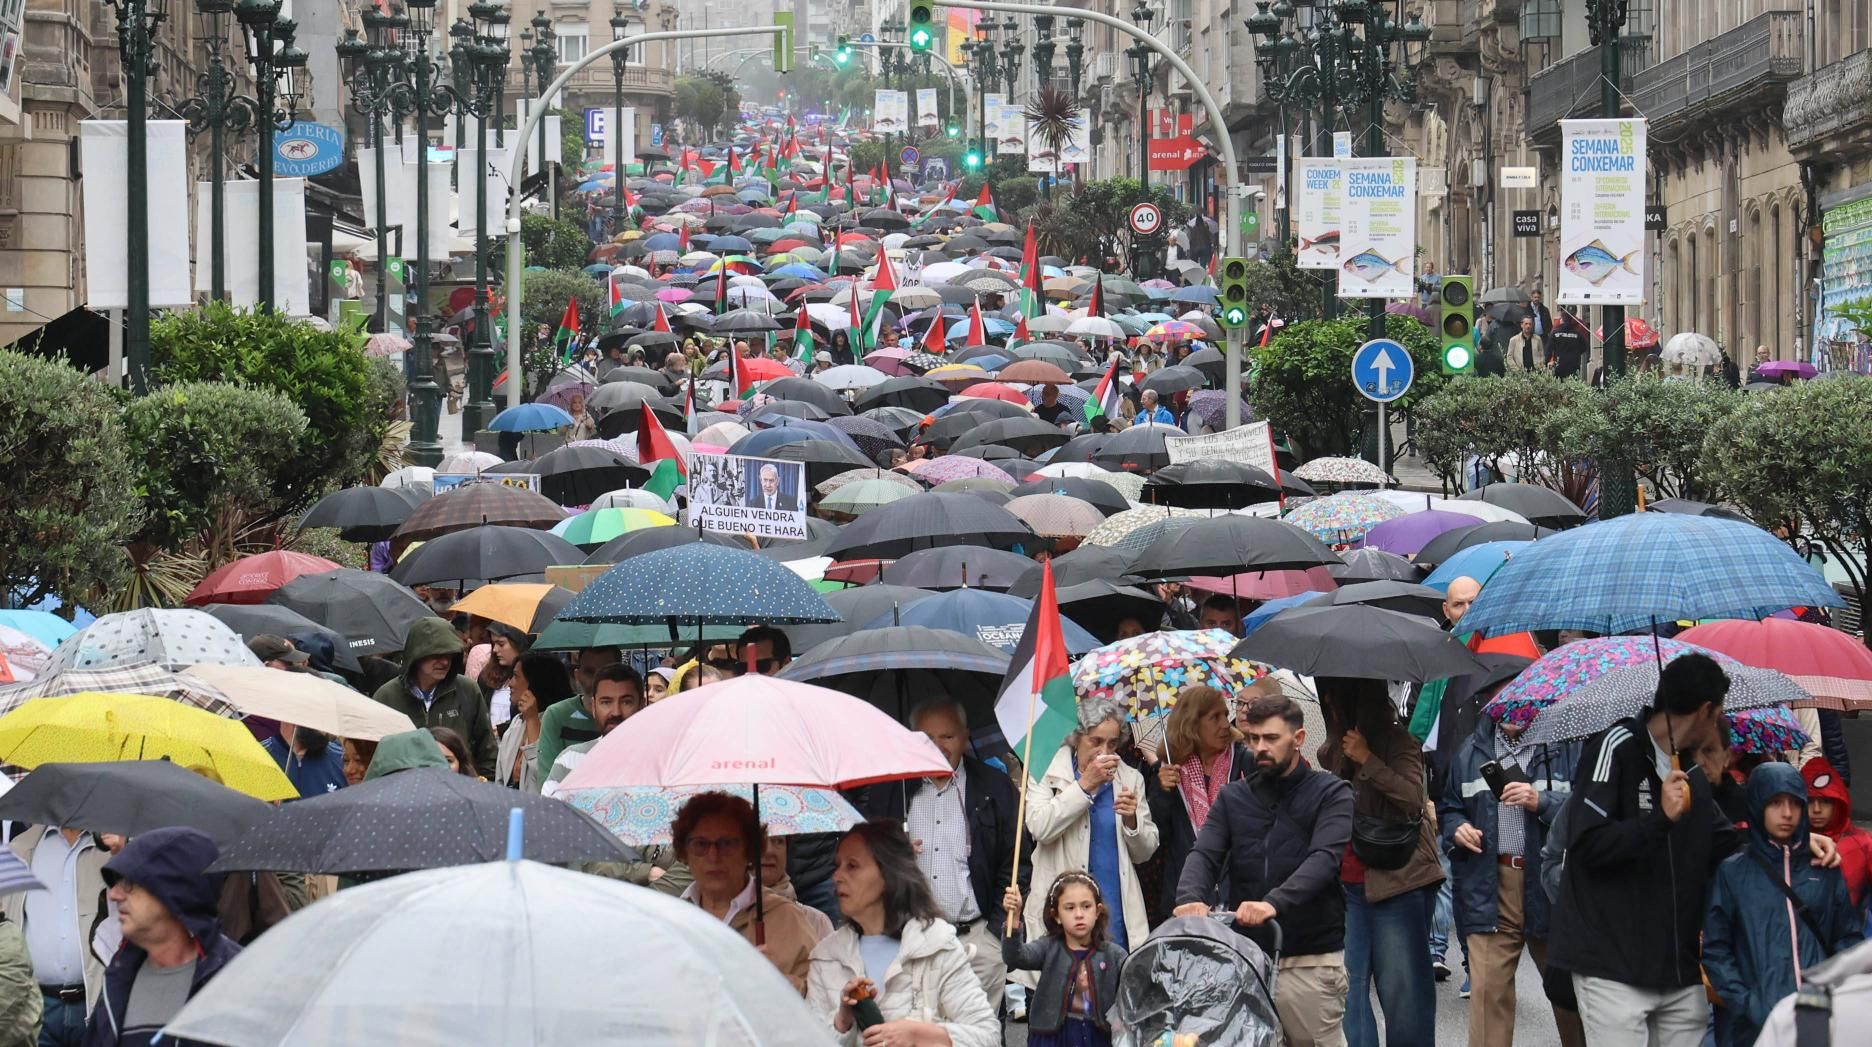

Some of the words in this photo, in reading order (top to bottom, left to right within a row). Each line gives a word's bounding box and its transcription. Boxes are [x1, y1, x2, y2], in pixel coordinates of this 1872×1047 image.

[1571, 139, 1619, 155] SEMANA
[1152, 150, 1180, 159] arenal
[1571, 156, 1634, 172] CONXEMAR
[1306, 180, 1329, 190] WEEK
[1348, 173, 1392, 185] SEMANA
[1348, 185, 1405, 198] CONXEMAR
[1136, 212, 1154, 223] 40
[1517, 224, 1537, 232] viva
[700, 505, 748, 518] ALGUIEN
[691, 518, 714, 530] QUE
[717, 520, 756, 533] BUENO
[758, 523, 772, 534] TE
[348, 638, 375, 649] INESIS
[711, 757, 776, 770] arenal
